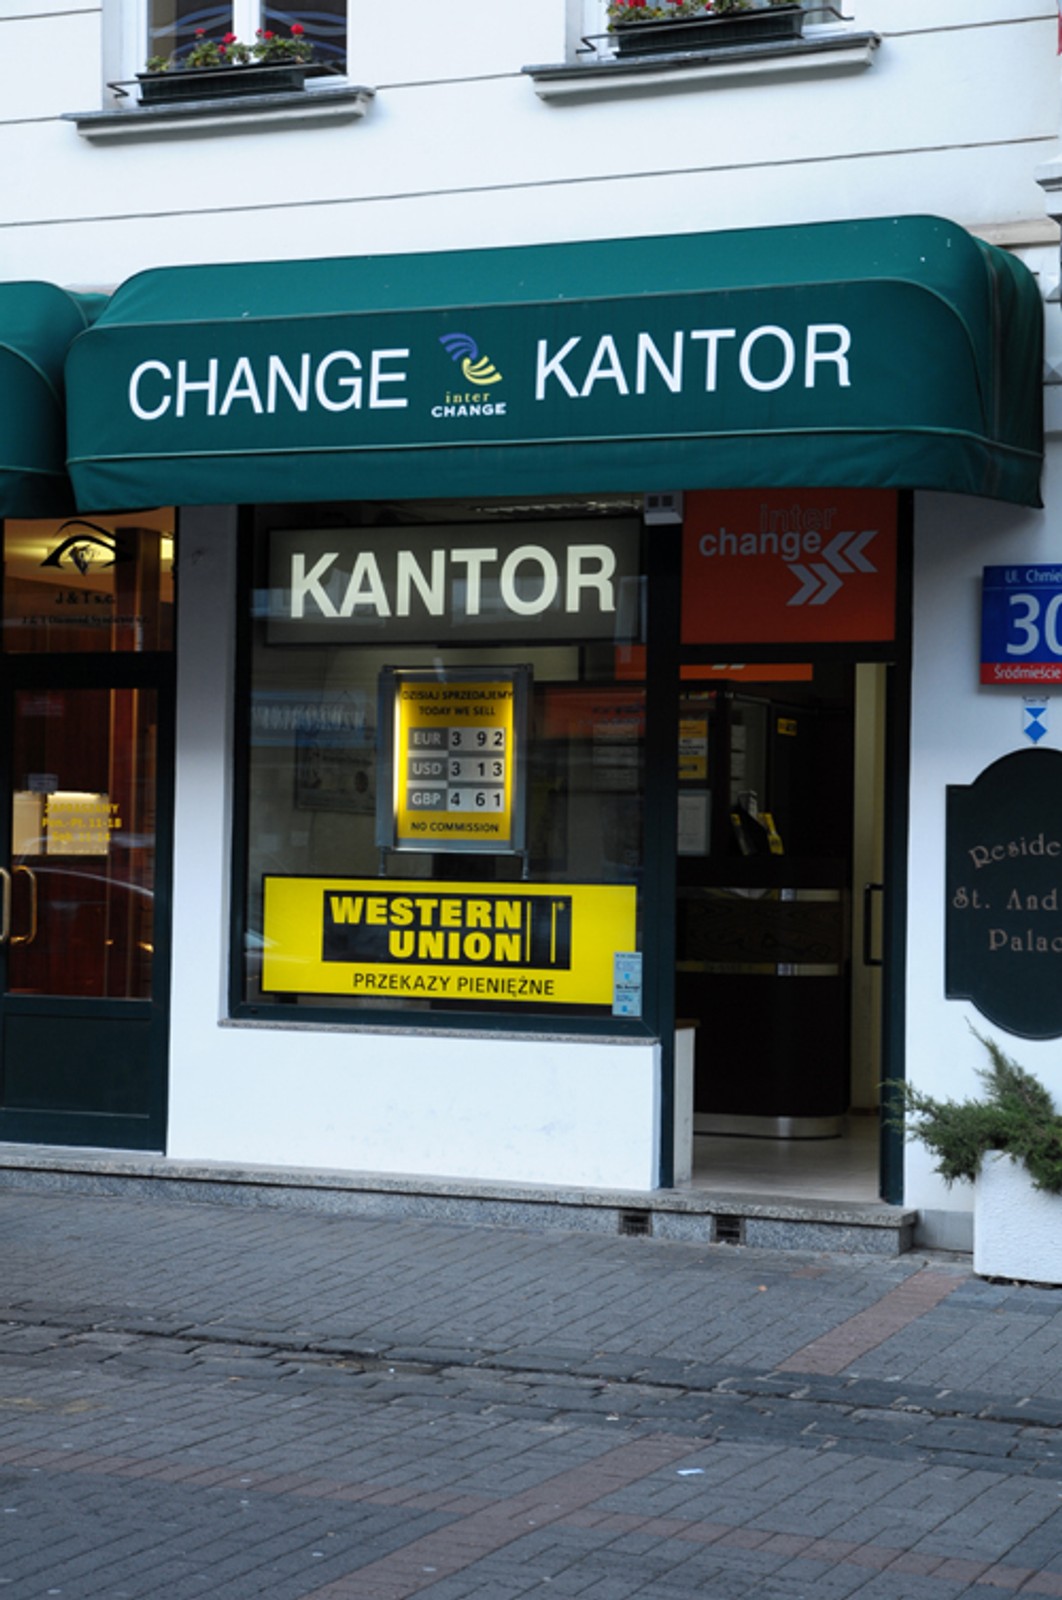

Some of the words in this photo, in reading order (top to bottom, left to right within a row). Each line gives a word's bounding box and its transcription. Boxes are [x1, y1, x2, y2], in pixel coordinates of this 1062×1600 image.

[128, 348, 409, 420] CHANGE
[535, 323, 851, 400] KANTOR
[445, 391, 490, 404] inter
[431, 402, 506, 418] CHANGE
[759, 503, 837, 531] inter
[698, 528, 821, 561] change
[291, 544, 616, 617] KANTOR
[994, 664, 1061, 679] Śródmieście
[419, 706, 451, 716] TODAY
[455, 706, 470, 716] WE
[473, 706, 496, 716] SELL
[413, 732, 441, 745] EUR
[412, 762, 443, 775] USD
[411, 792, 441, 805] GBP
[411, 821, 427, 831] NO
[430, 821, 499, 833] COMMISSION
[953, 886, 990, 909] St.
[1006, 888, 1058, 911] And
[329, 896, 521, 930] WESTERN
[388, 930, 521, 962] UNION
[353, 972, 451, 992] PRZEKAZY
[457, 975, 554, 998] PIENIĘŻNE
